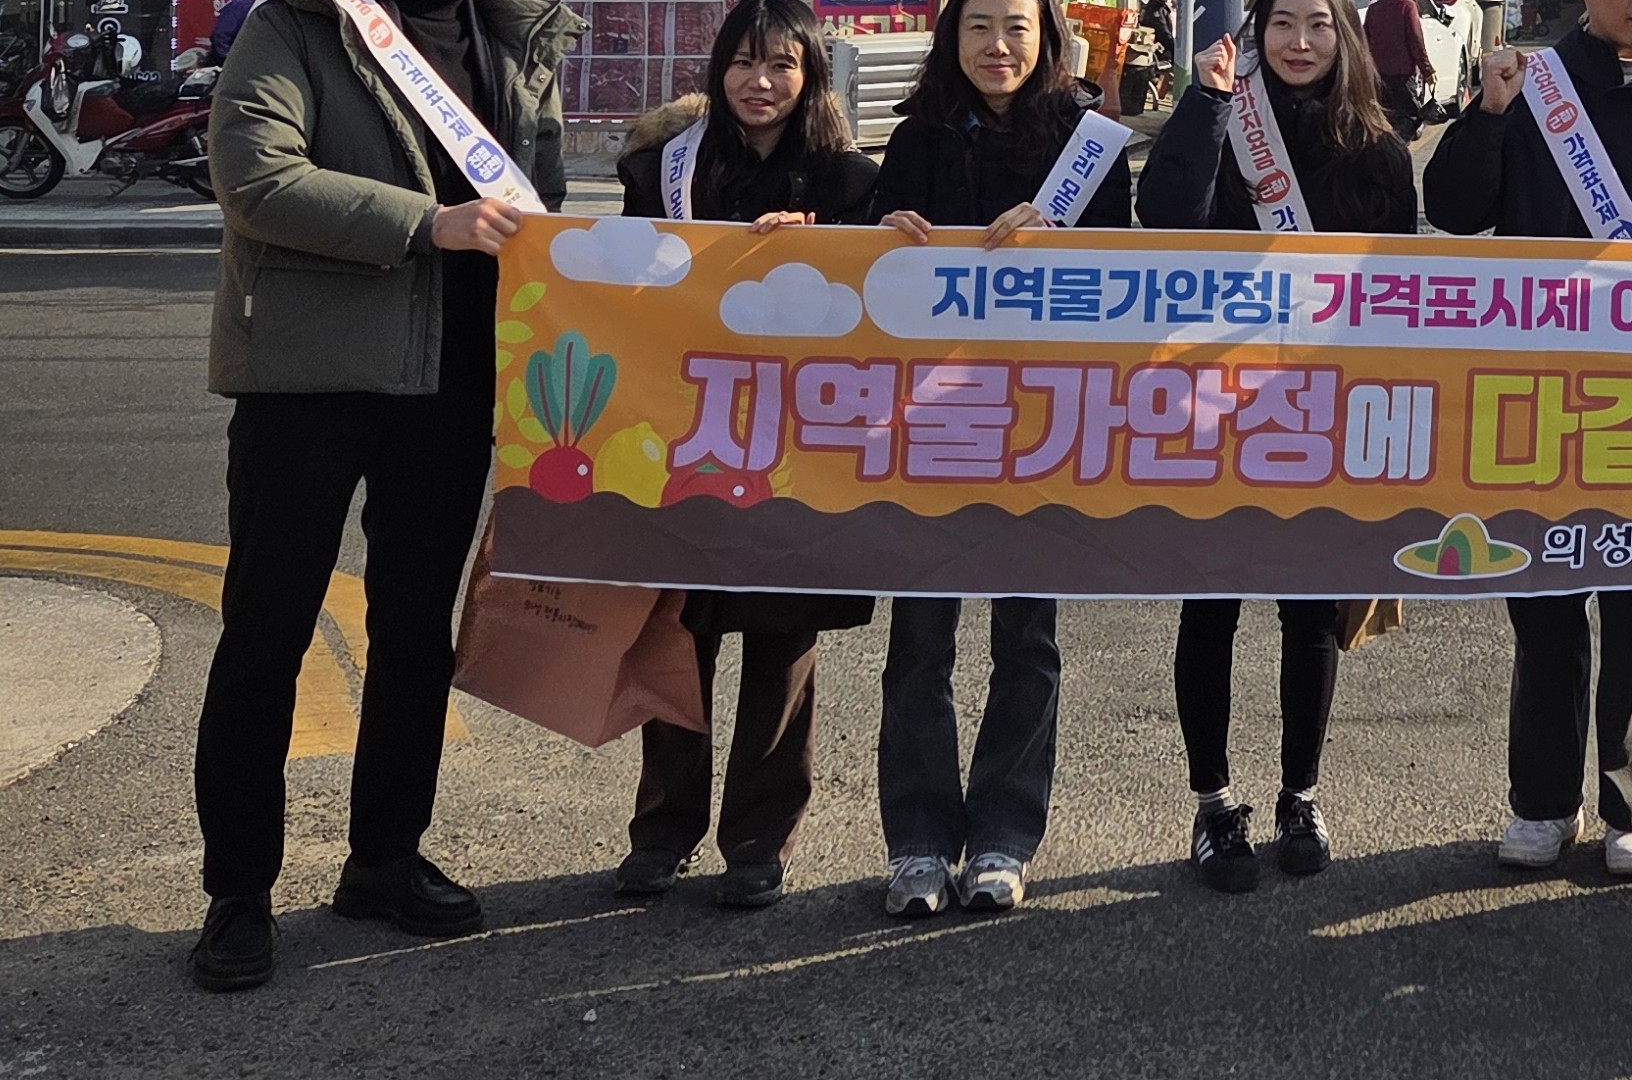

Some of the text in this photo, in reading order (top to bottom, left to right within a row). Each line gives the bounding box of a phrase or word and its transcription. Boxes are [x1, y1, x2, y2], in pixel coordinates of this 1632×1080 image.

[1048, 138, 1105, 217] 우리 모두
[1562, 132, 1620, 225] 가격표시제
[931, 264, 1292, 324] 지역물가안정!
[1311, 272, 1592, 334] 가격표시제
[671, 356, 1435, 482] 지역물가안정에
